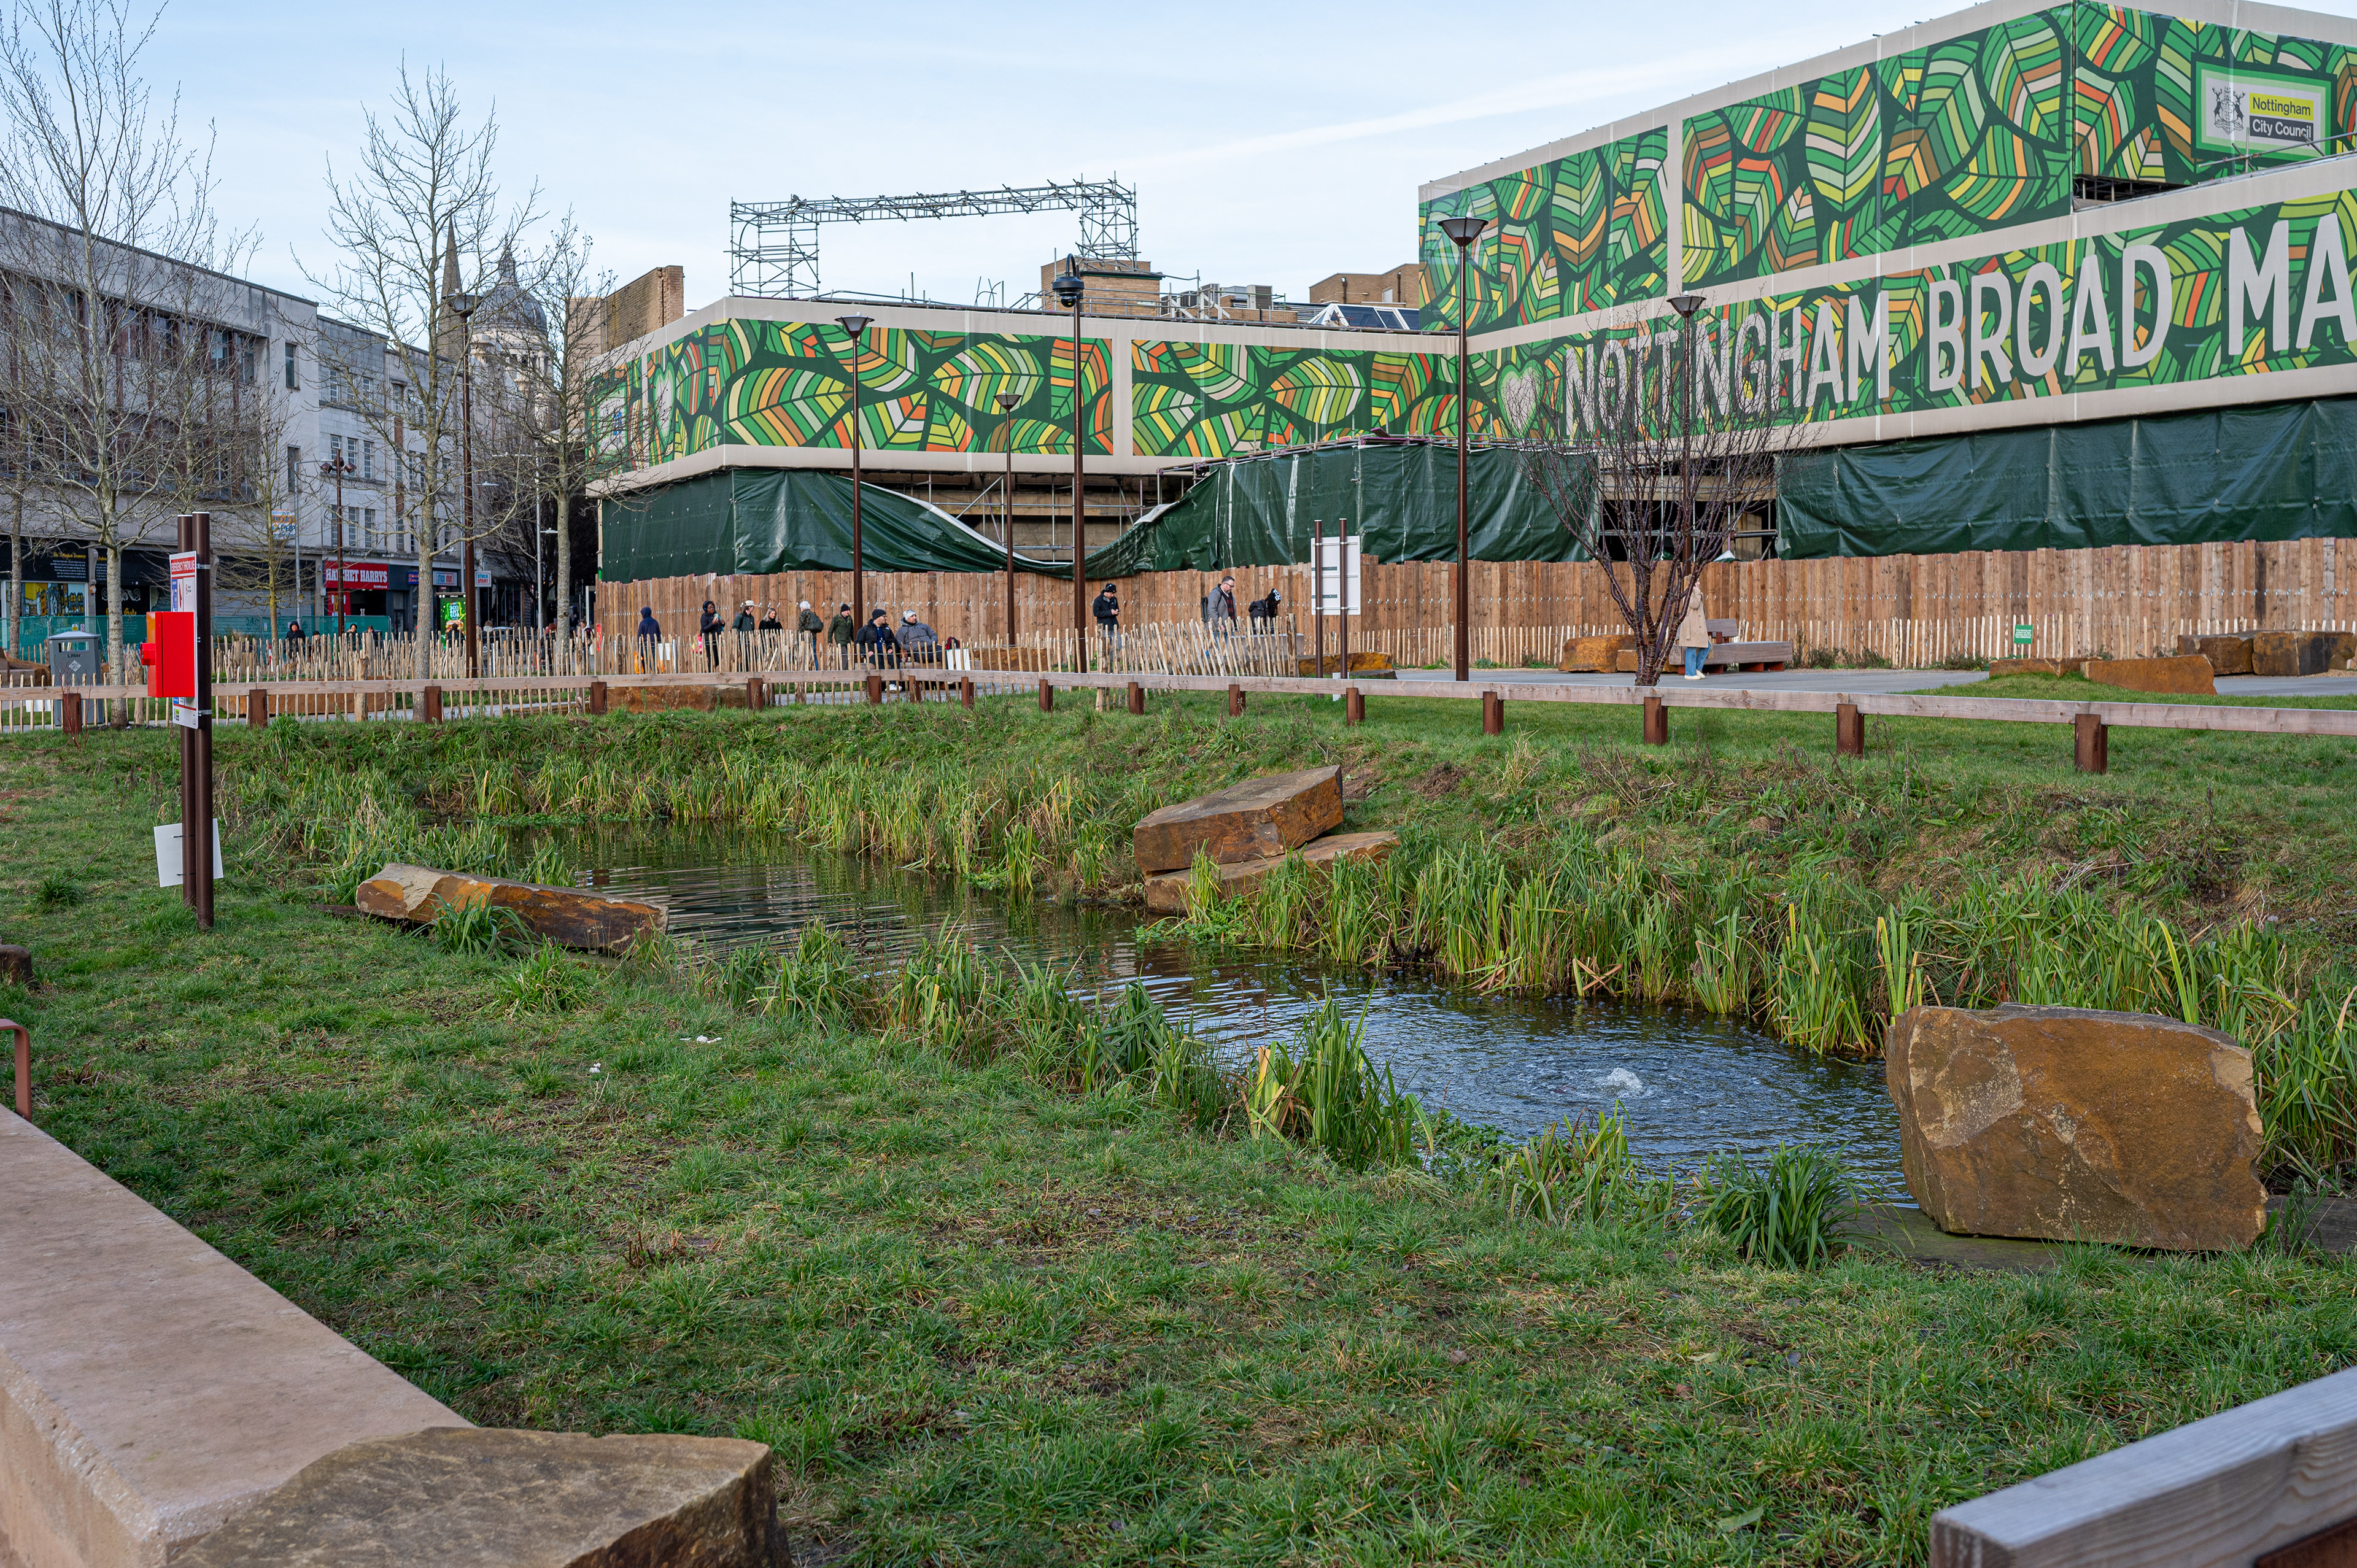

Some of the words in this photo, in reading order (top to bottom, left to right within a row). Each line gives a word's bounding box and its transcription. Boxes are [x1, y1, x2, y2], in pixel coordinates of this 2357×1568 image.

[2253, 96, 2311, 116] Nottingham
[2252, 118, 2273, 136] City
[2275, 121, 2312, 139] Council
[1929, 244, 2173, 393] BROAD
[2228, 212, 2357, 356] MA
[360, 570, 387, 583] HARRYS
